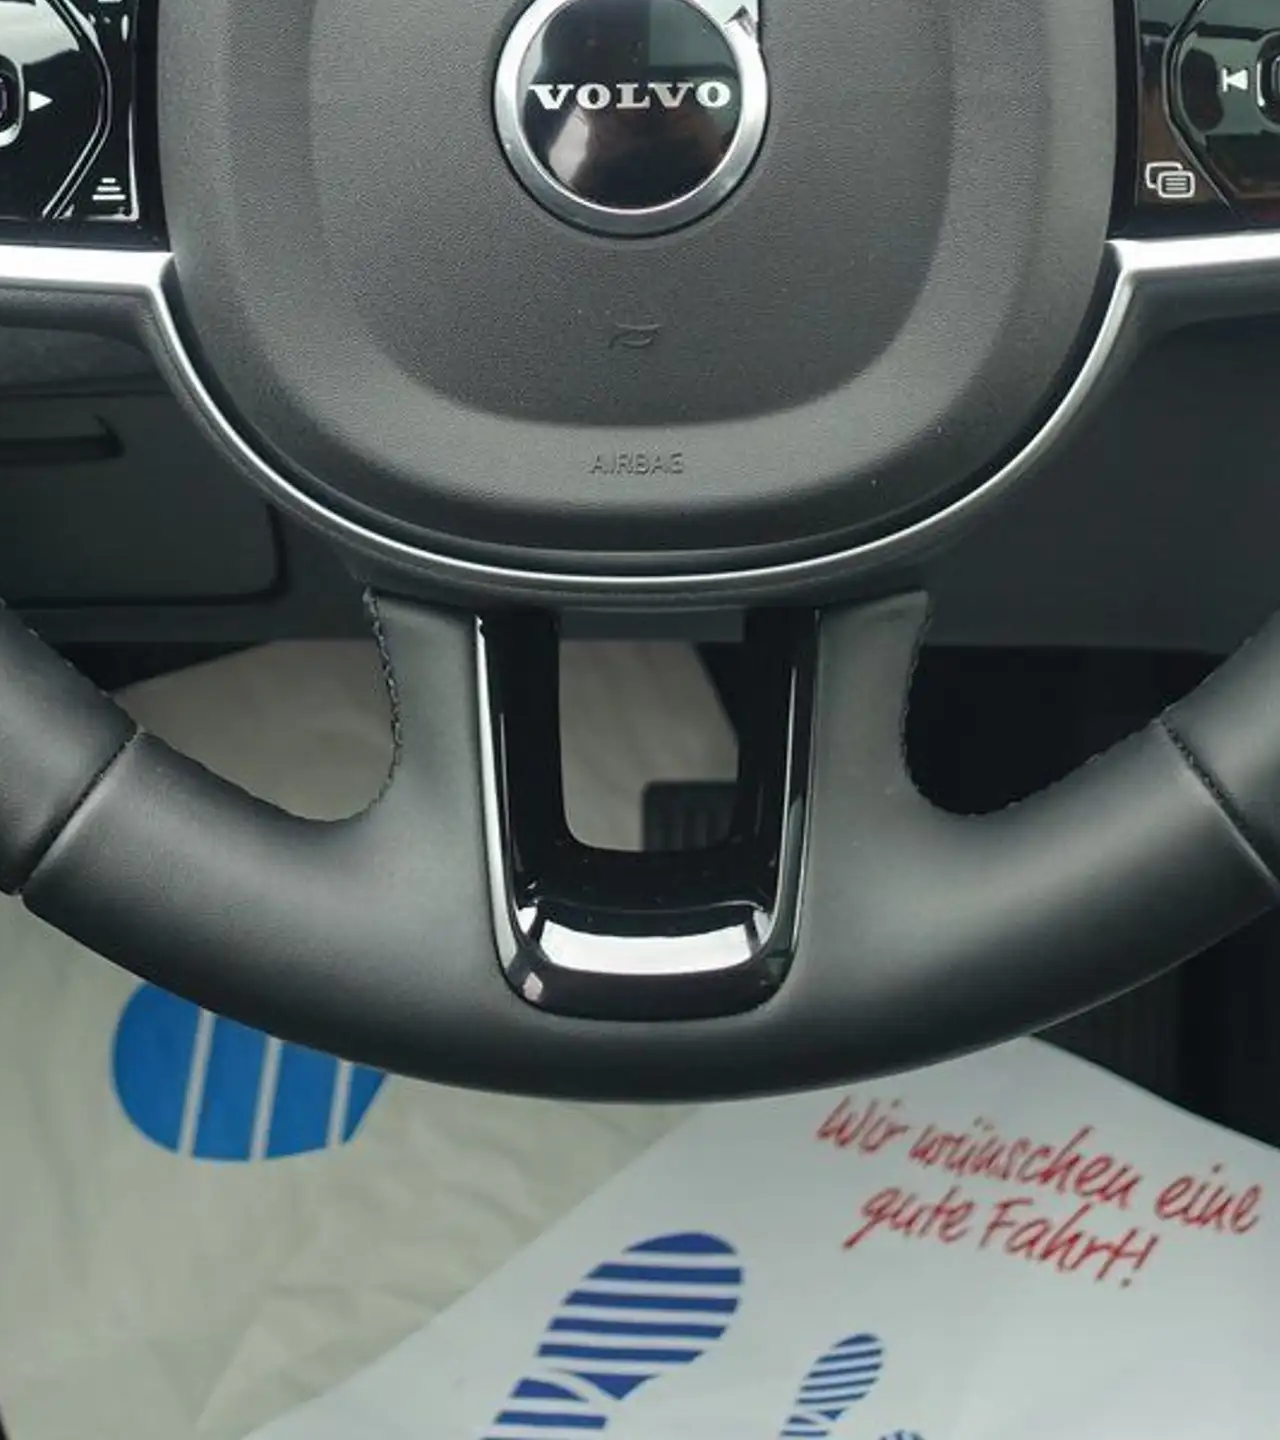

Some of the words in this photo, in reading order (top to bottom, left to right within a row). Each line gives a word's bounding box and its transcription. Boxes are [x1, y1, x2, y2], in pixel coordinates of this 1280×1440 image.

[528, 81, 732, 110] VOLVO
[587, 450, 686, 476] AIRBAG
[817, 1096, 912, 1154] Wir
[908, 1116, 1145, 1210] wünschen
[1153, 1163, 1263, 1235] eine
[842, 1185, 977, 1250] gute
[978, 1196, 1161, 1289] Fahrt!
